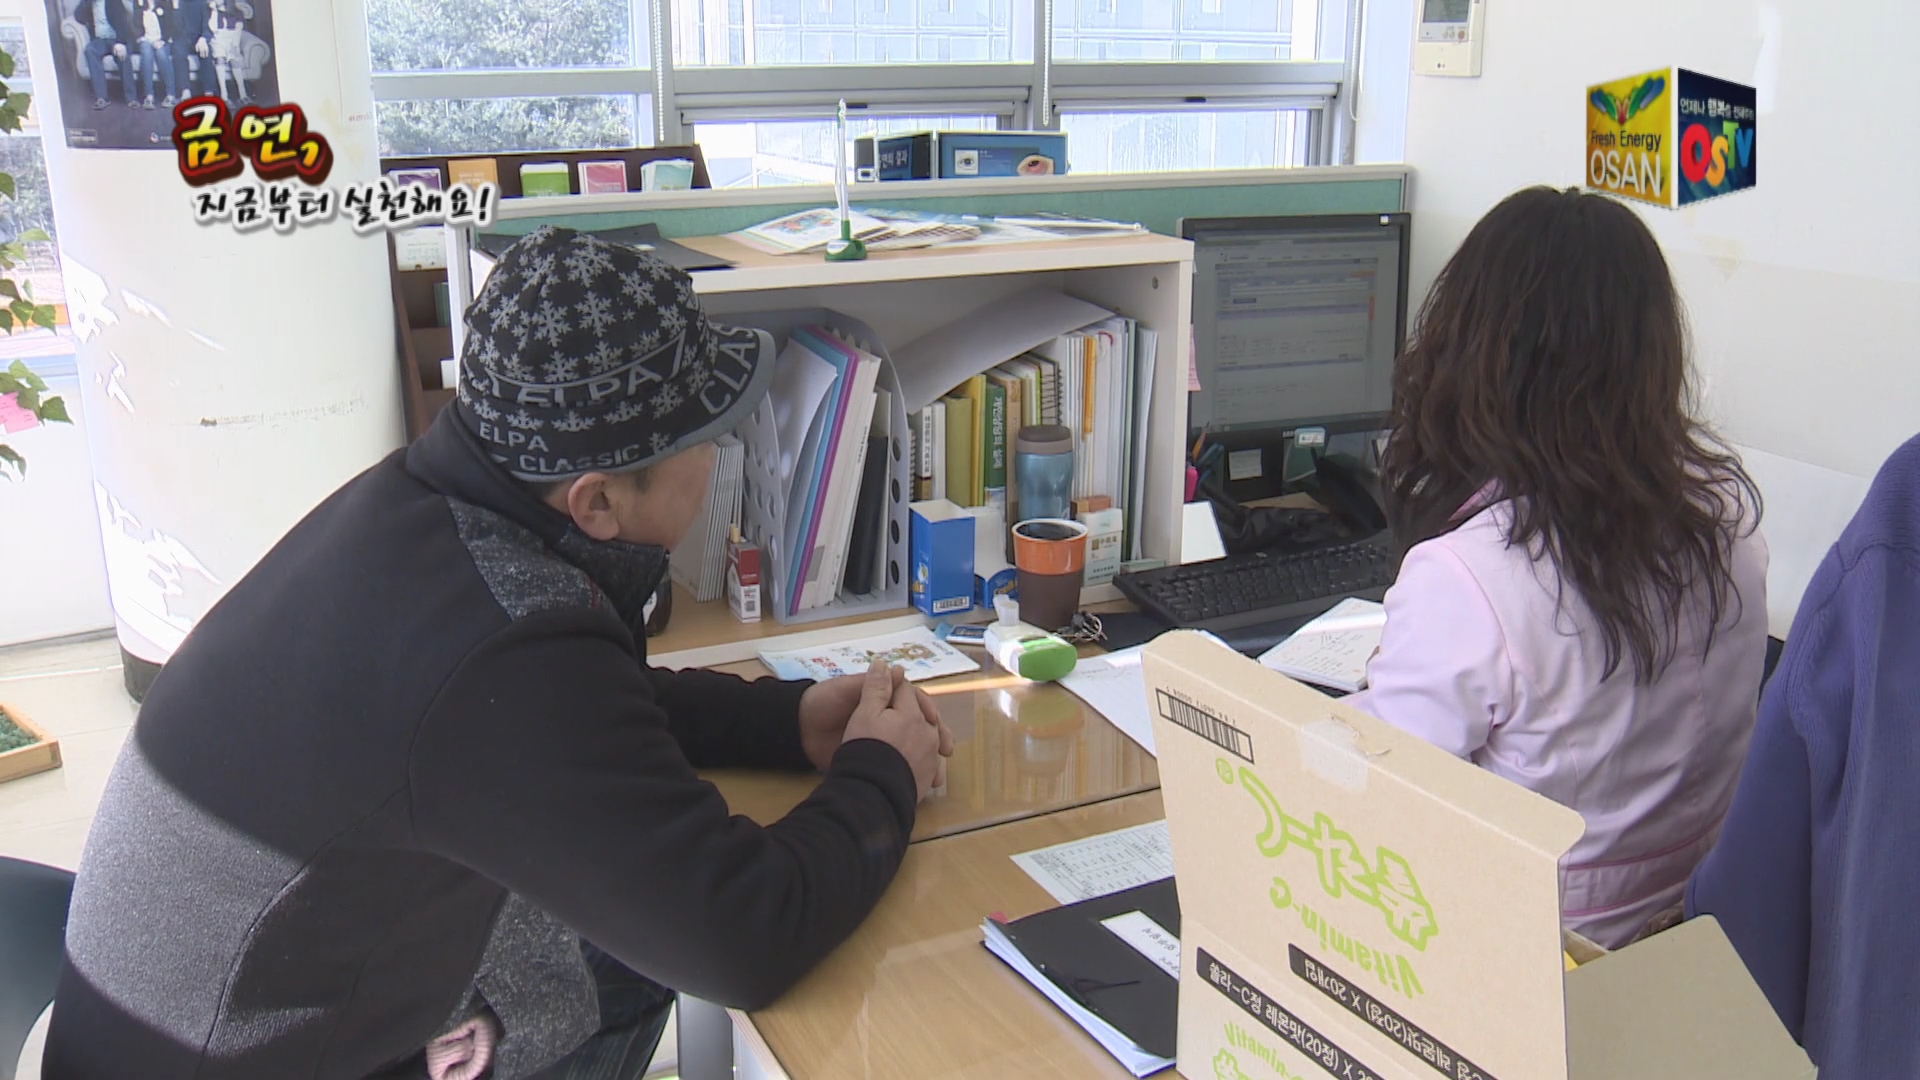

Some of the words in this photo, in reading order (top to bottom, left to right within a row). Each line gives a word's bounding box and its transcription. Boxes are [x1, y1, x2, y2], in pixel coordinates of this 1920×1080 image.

[479, 421, 549, 453] ELPA
[519, 443, 641, 473] CLASSIC
[1269, 876, 1424, 1000] Vitamin-C
[1304, 958, 1347, 1001] 20개입
[1209, 961, 1262, 1014] 쏠라-C정
[1265, 1003, 1339, 1071] 레몬맛(20정)
